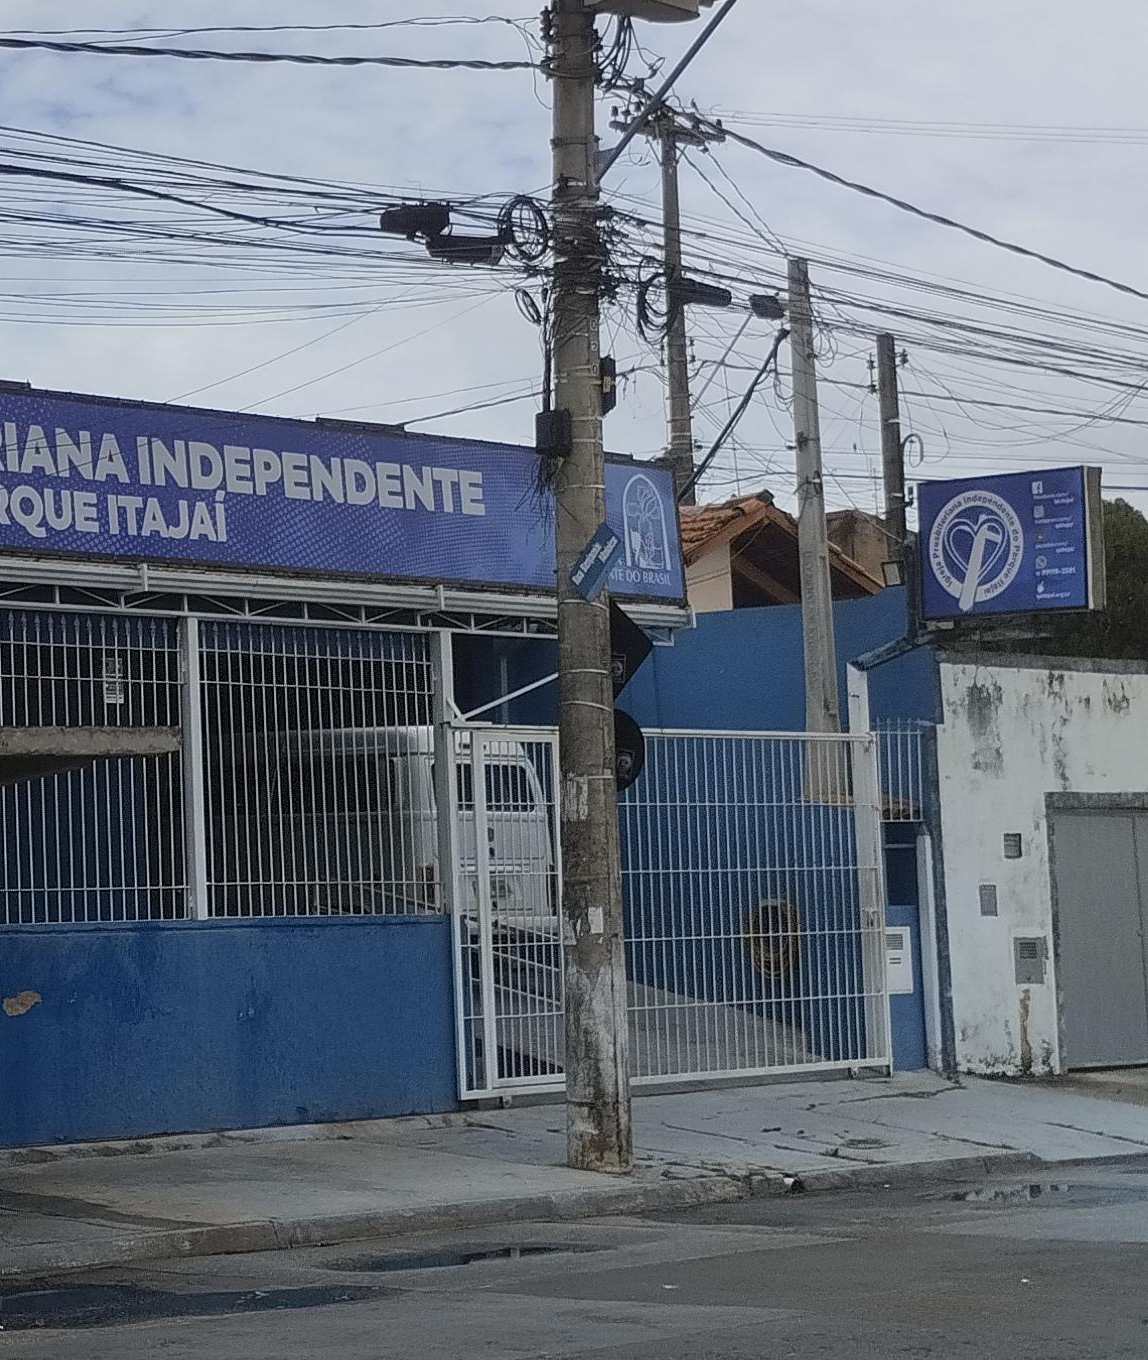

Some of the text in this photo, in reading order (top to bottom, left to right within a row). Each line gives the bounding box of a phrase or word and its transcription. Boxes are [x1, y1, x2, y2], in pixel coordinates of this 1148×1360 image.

[136, 436, 485, 517] INDEPENDENTE
[106, 490, 229, 543] ITAJAÍ
[642, 570, 672, 587] BRASIL
